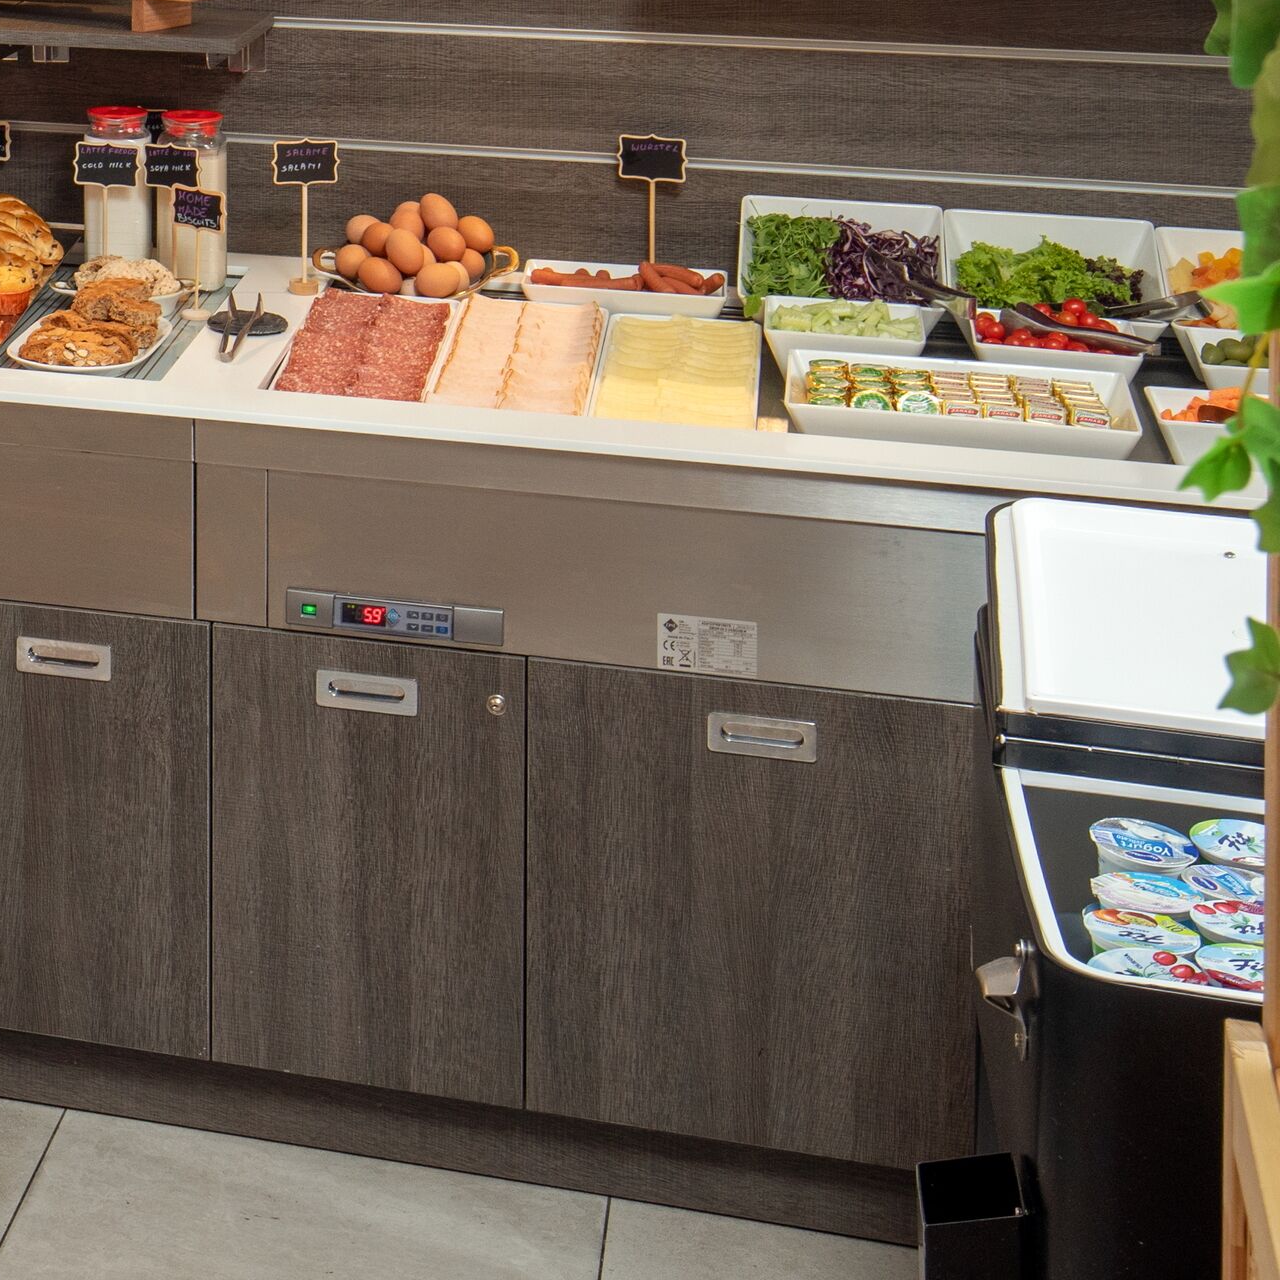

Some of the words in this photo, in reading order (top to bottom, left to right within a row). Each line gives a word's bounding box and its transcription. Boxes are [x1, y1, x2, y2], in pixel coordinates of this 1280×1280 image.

[286, 147, 329, 157] SALAME
[631, 143, 679, 153] WURSTEL
[150, 164, 169, 172] SOYA
[172, 164, 191, 172] MILK
[281, 163, 321, 172] SALAMI
[178, 191, 212, 206] HOME
[178, 205, 208, 217] MADE
[1218, 832, 1249, 851] Fit
[1120, 840, 1171, 857] Yogurt
